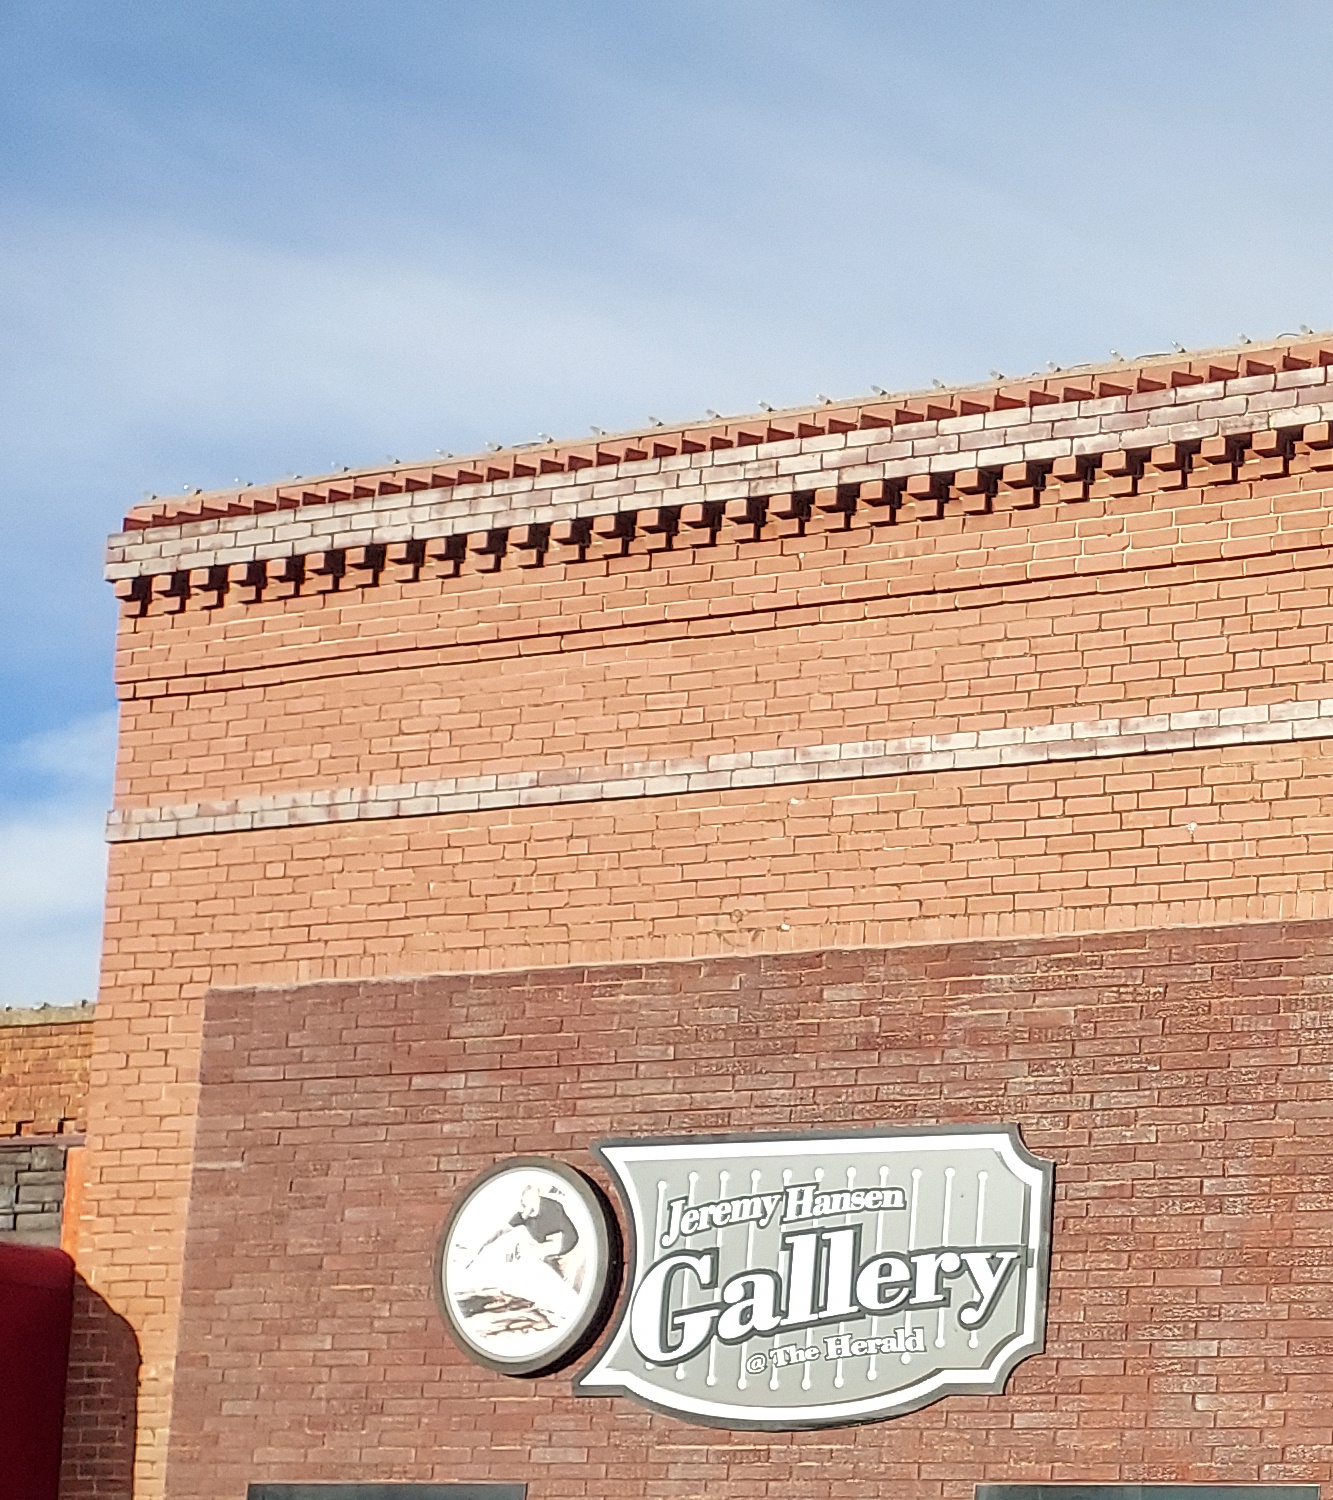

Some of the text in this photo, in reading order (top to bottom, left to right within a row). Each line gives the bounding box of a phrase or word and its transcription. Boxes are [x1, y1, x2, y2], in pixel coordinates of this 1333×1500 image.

[660, 1184, 906, 1248] Jeremy Hansen
[630, 1227, 1022, 1364] Gallery
[746, 1327, 926, 1374] @ The Herald
